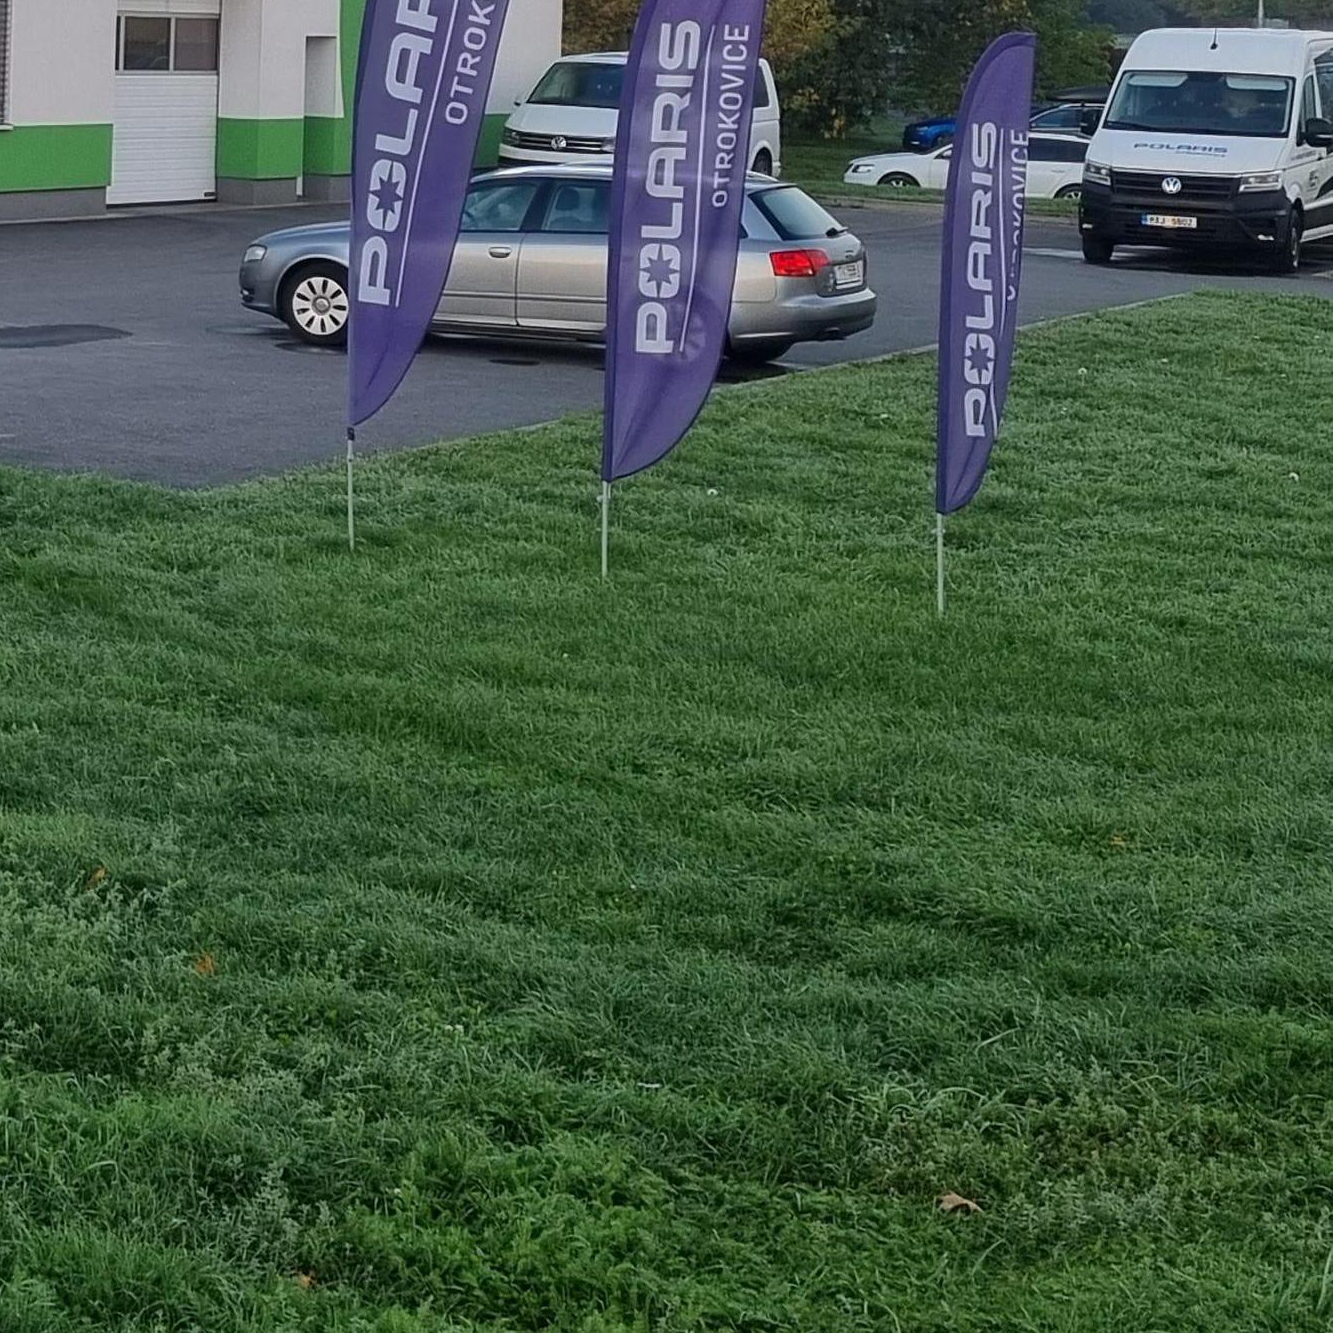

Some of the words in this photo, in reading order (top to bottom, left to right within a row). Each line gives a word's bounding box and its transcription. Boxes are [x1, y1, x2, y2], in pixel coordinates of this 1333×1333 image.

[635, 19, 701, 354] POLARIS
[711, 24, 750, 208] OTROKOVICE
[964, 121, 997, 438] POLARIS
